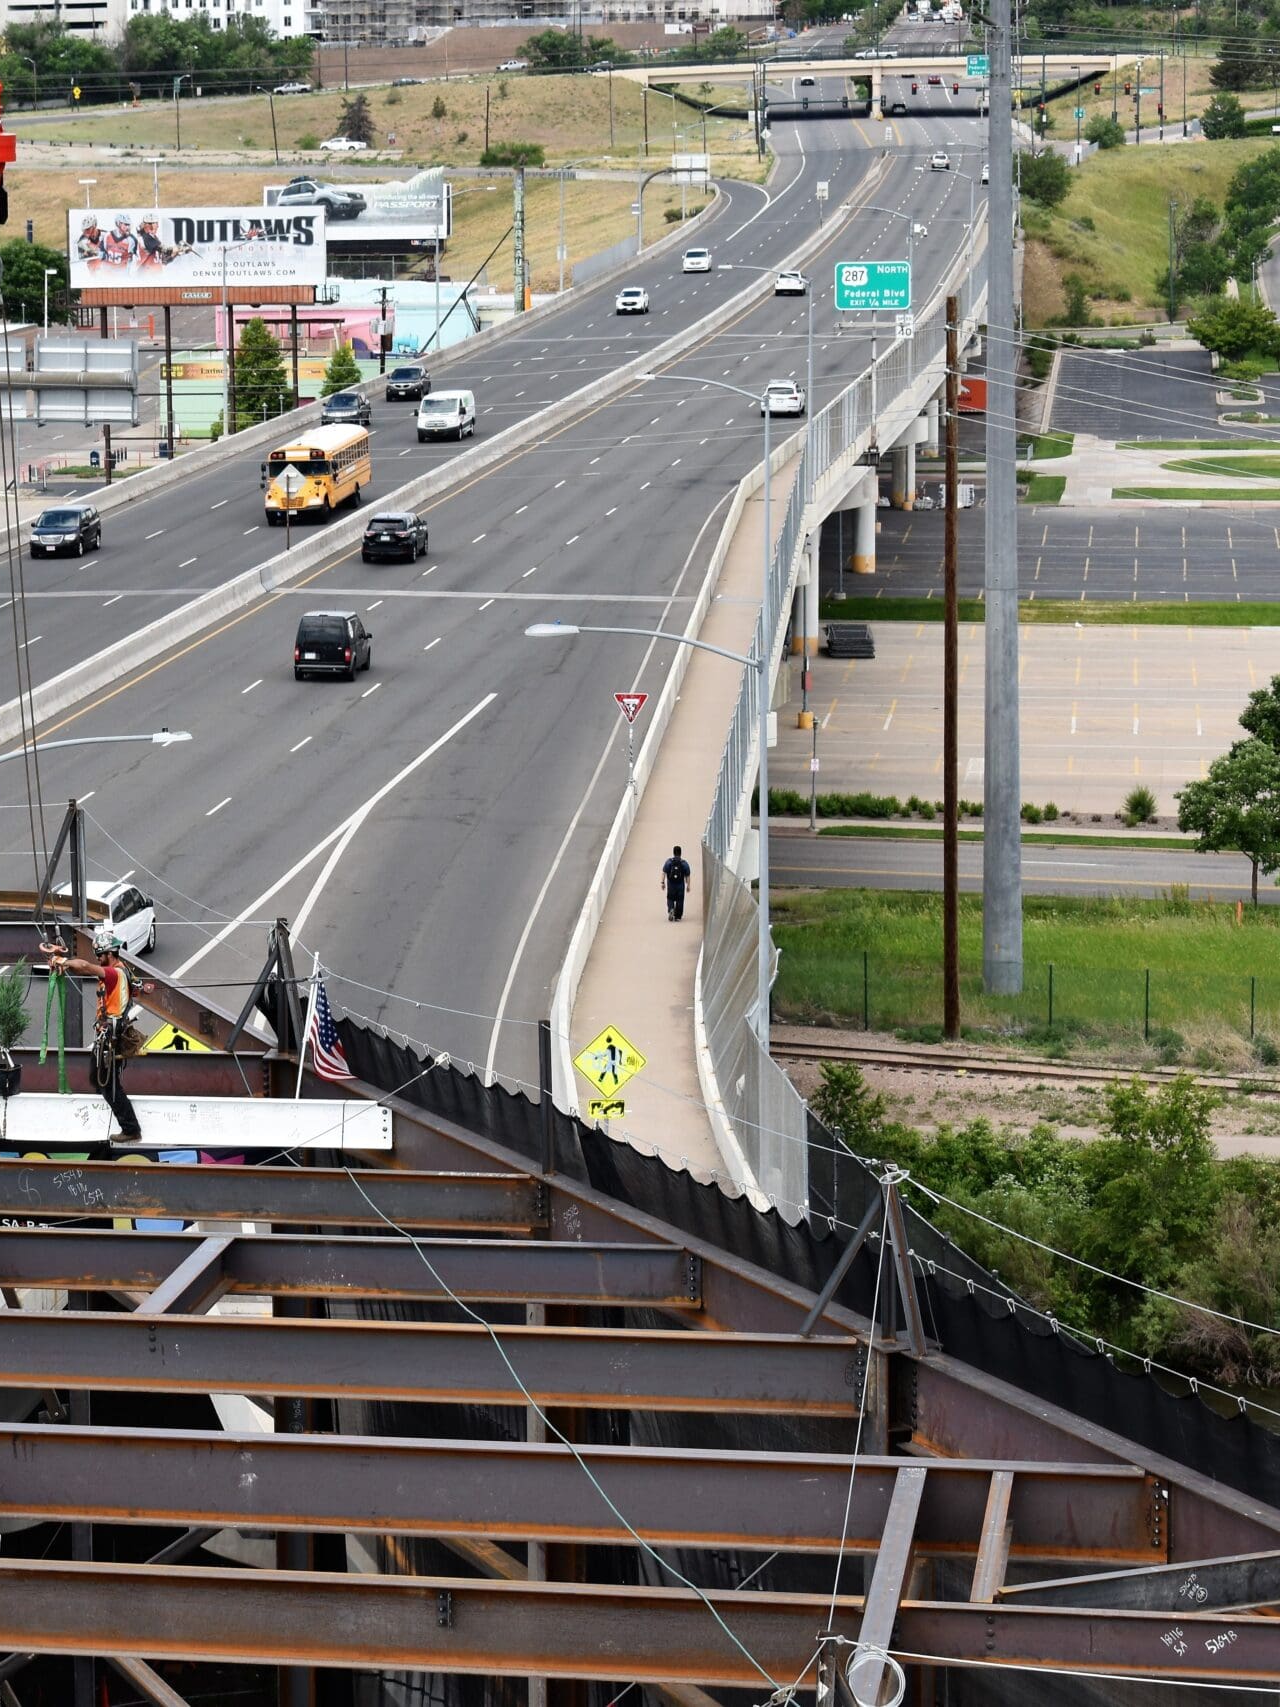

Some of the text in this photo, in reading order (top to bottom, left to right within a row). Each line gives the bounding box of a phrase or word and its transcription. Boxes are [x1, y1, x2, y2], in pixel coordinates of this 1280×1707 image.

[373, 201, 438, 209] PASSPORT
[169, 216, 320, 246] OUTLAWS
[844, 265, 908, 282] 287 NORTH
[844, 289, 905, 298] Federal Blvd
